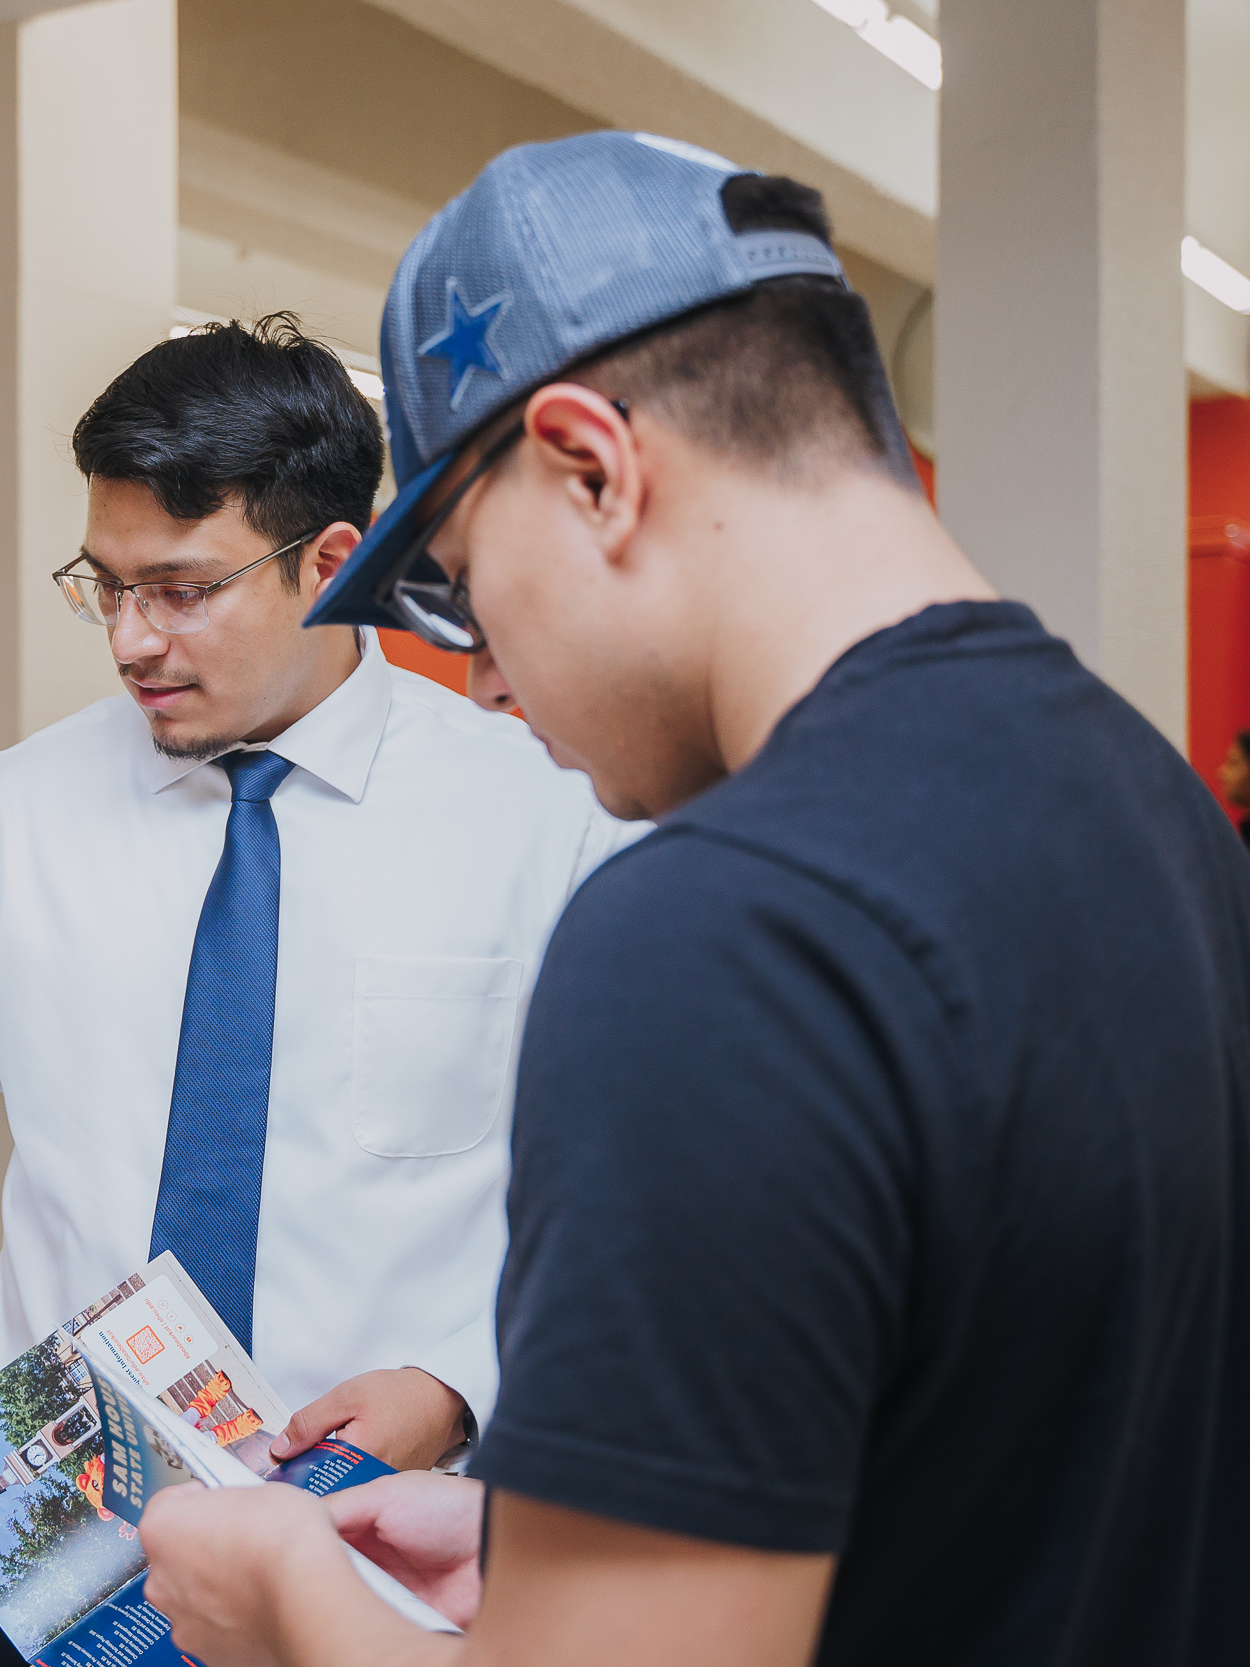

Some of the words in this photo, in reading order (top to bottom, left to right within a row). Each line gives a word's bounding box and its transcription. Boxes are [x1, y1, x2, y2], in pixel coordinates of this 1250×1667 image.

[145, 1298, 164, 1323] shsu.edu
[98, 1331, 127, 1368] Information
[106, 1329, 150, 1386] shsu.edu/beabearkat
[97, 1376, 125, 1440] HOUS
[112, 1440, 128, 1498] SAM
[130, 1447, 143, 1509] STATE
